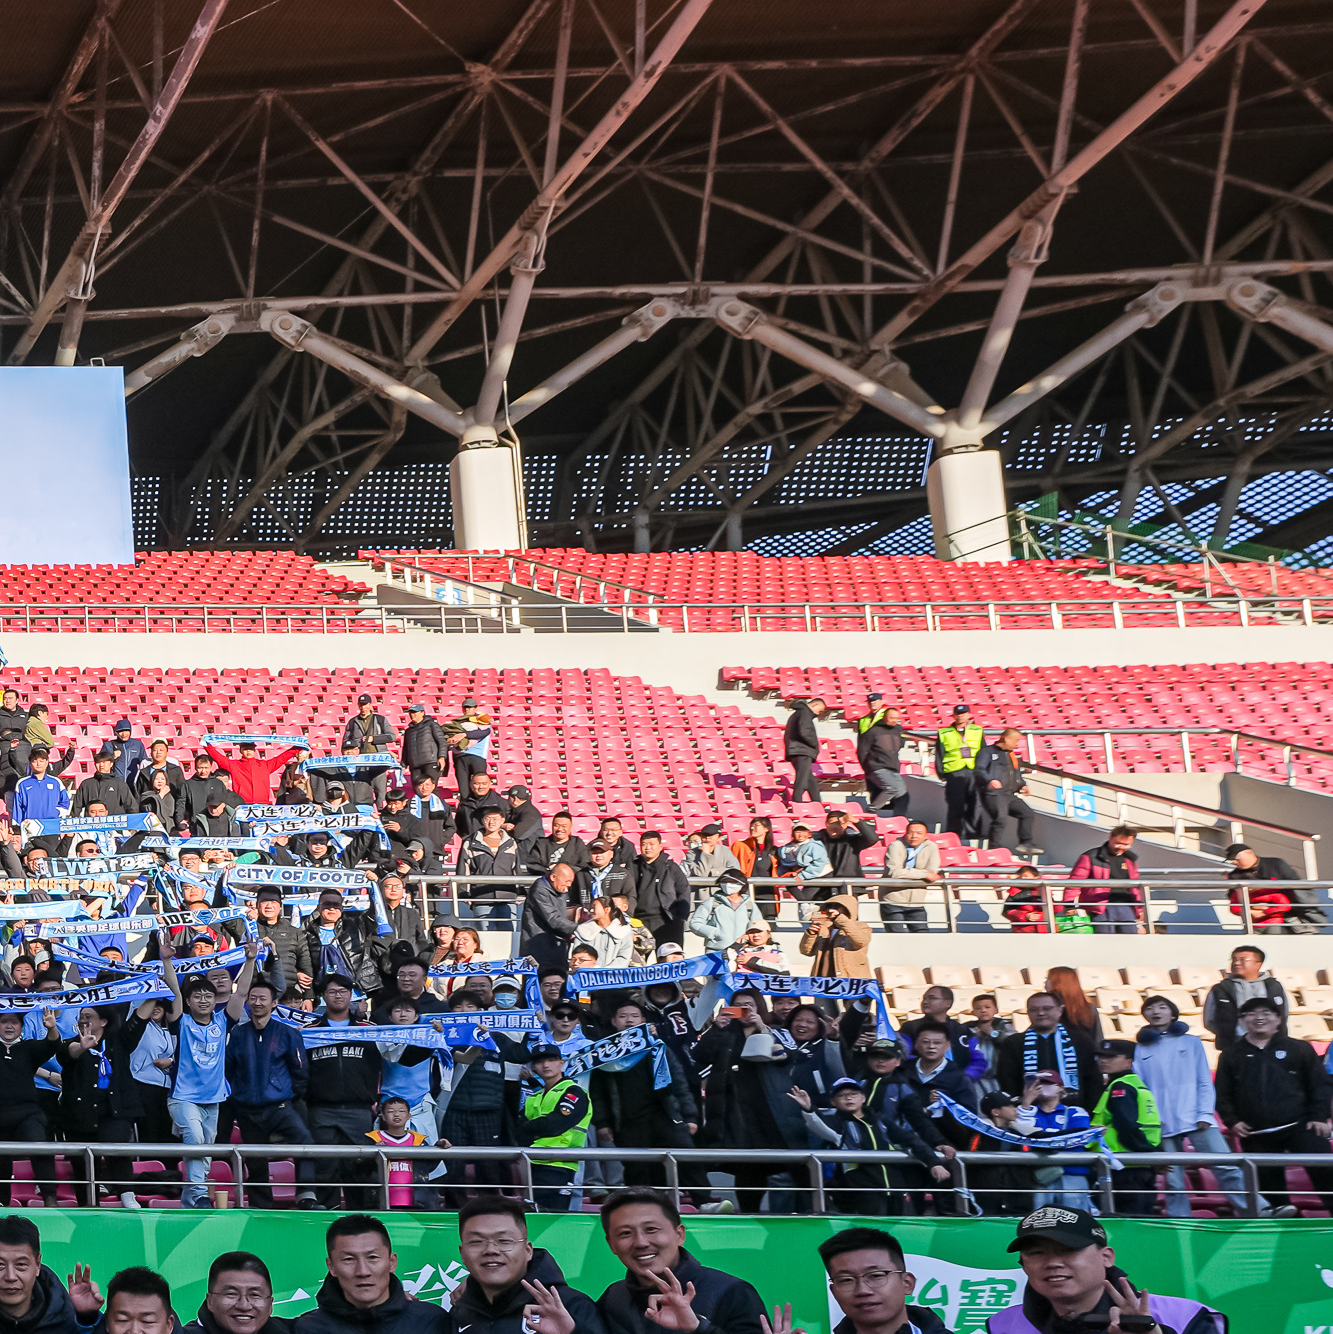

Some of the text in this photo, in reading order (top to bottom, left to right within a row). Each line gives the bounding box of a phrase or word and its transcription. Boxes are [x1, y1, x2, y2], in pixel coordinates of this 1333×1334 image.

[245, 806, 278, 819] 大连
[263, 815, 364, 836] 大连 必胜
[236, 868, 368, 885] CITY OF FOOTB
[579, 961, 688, 988] DALIAN YINGBO FC
[738, 973, 793, 992] 大连
[64, 986, 118, 1005] 必胜
[342, 1046, 365, 1058] SAKI
